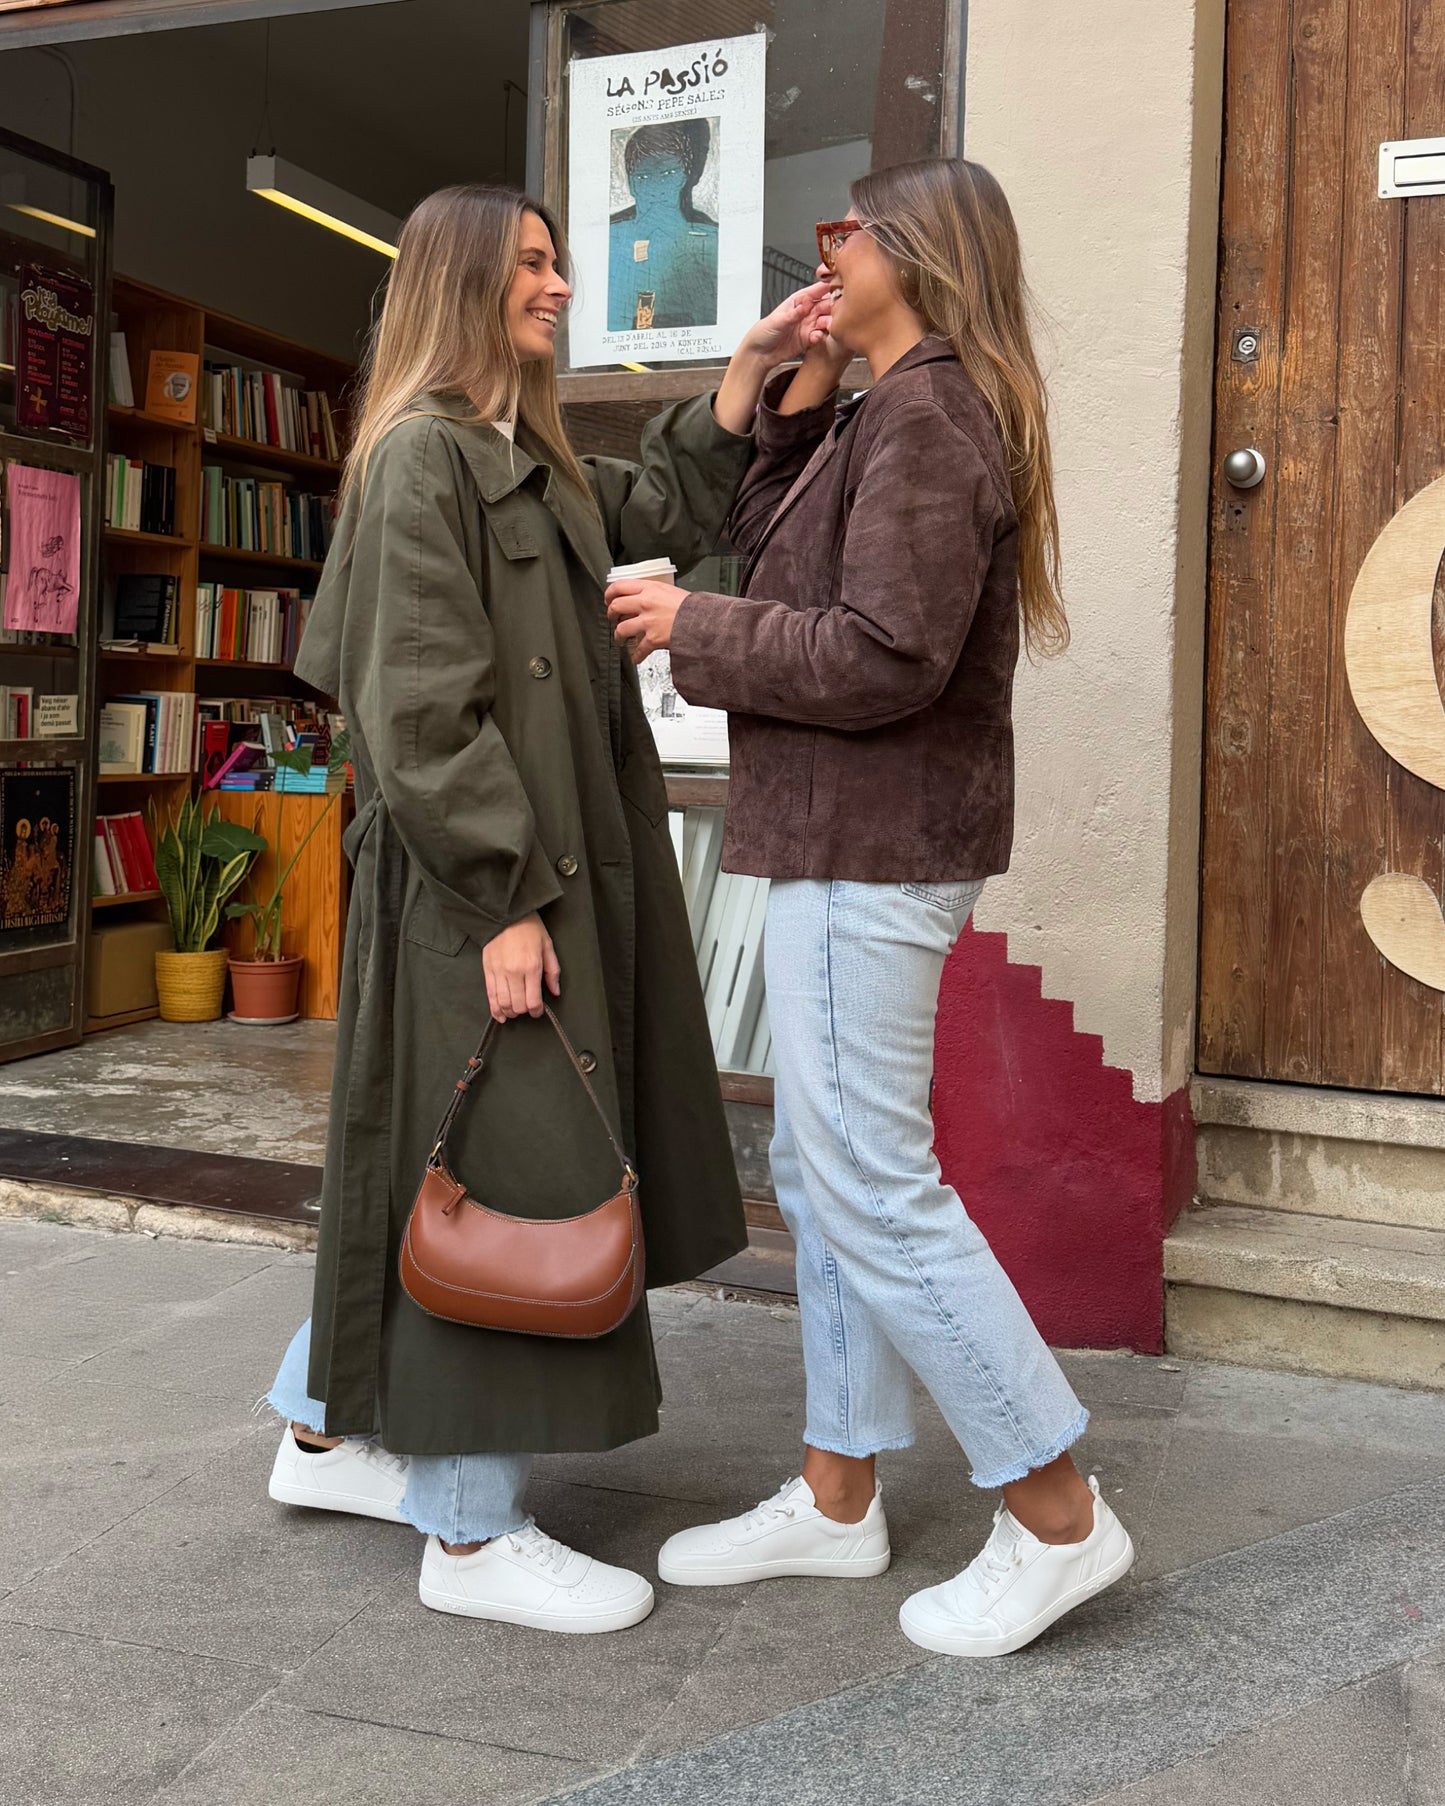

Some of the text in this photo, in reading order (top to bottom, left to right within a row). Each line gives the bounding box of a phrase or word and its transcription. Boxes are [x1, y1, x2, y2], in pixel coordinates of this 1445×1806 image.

[607, 76, 635, 97] LA
[657, 96, 684, 110] PEPE
[687, 89, 725, 105] SALES
[602, 335, 617, 344] DEL
[681, 329, 691, 337] DE
[633, 342, 648, 350] DEL
[651, 341, 667, 349] 2019
[678, 337, 712, 347] KONVENT
